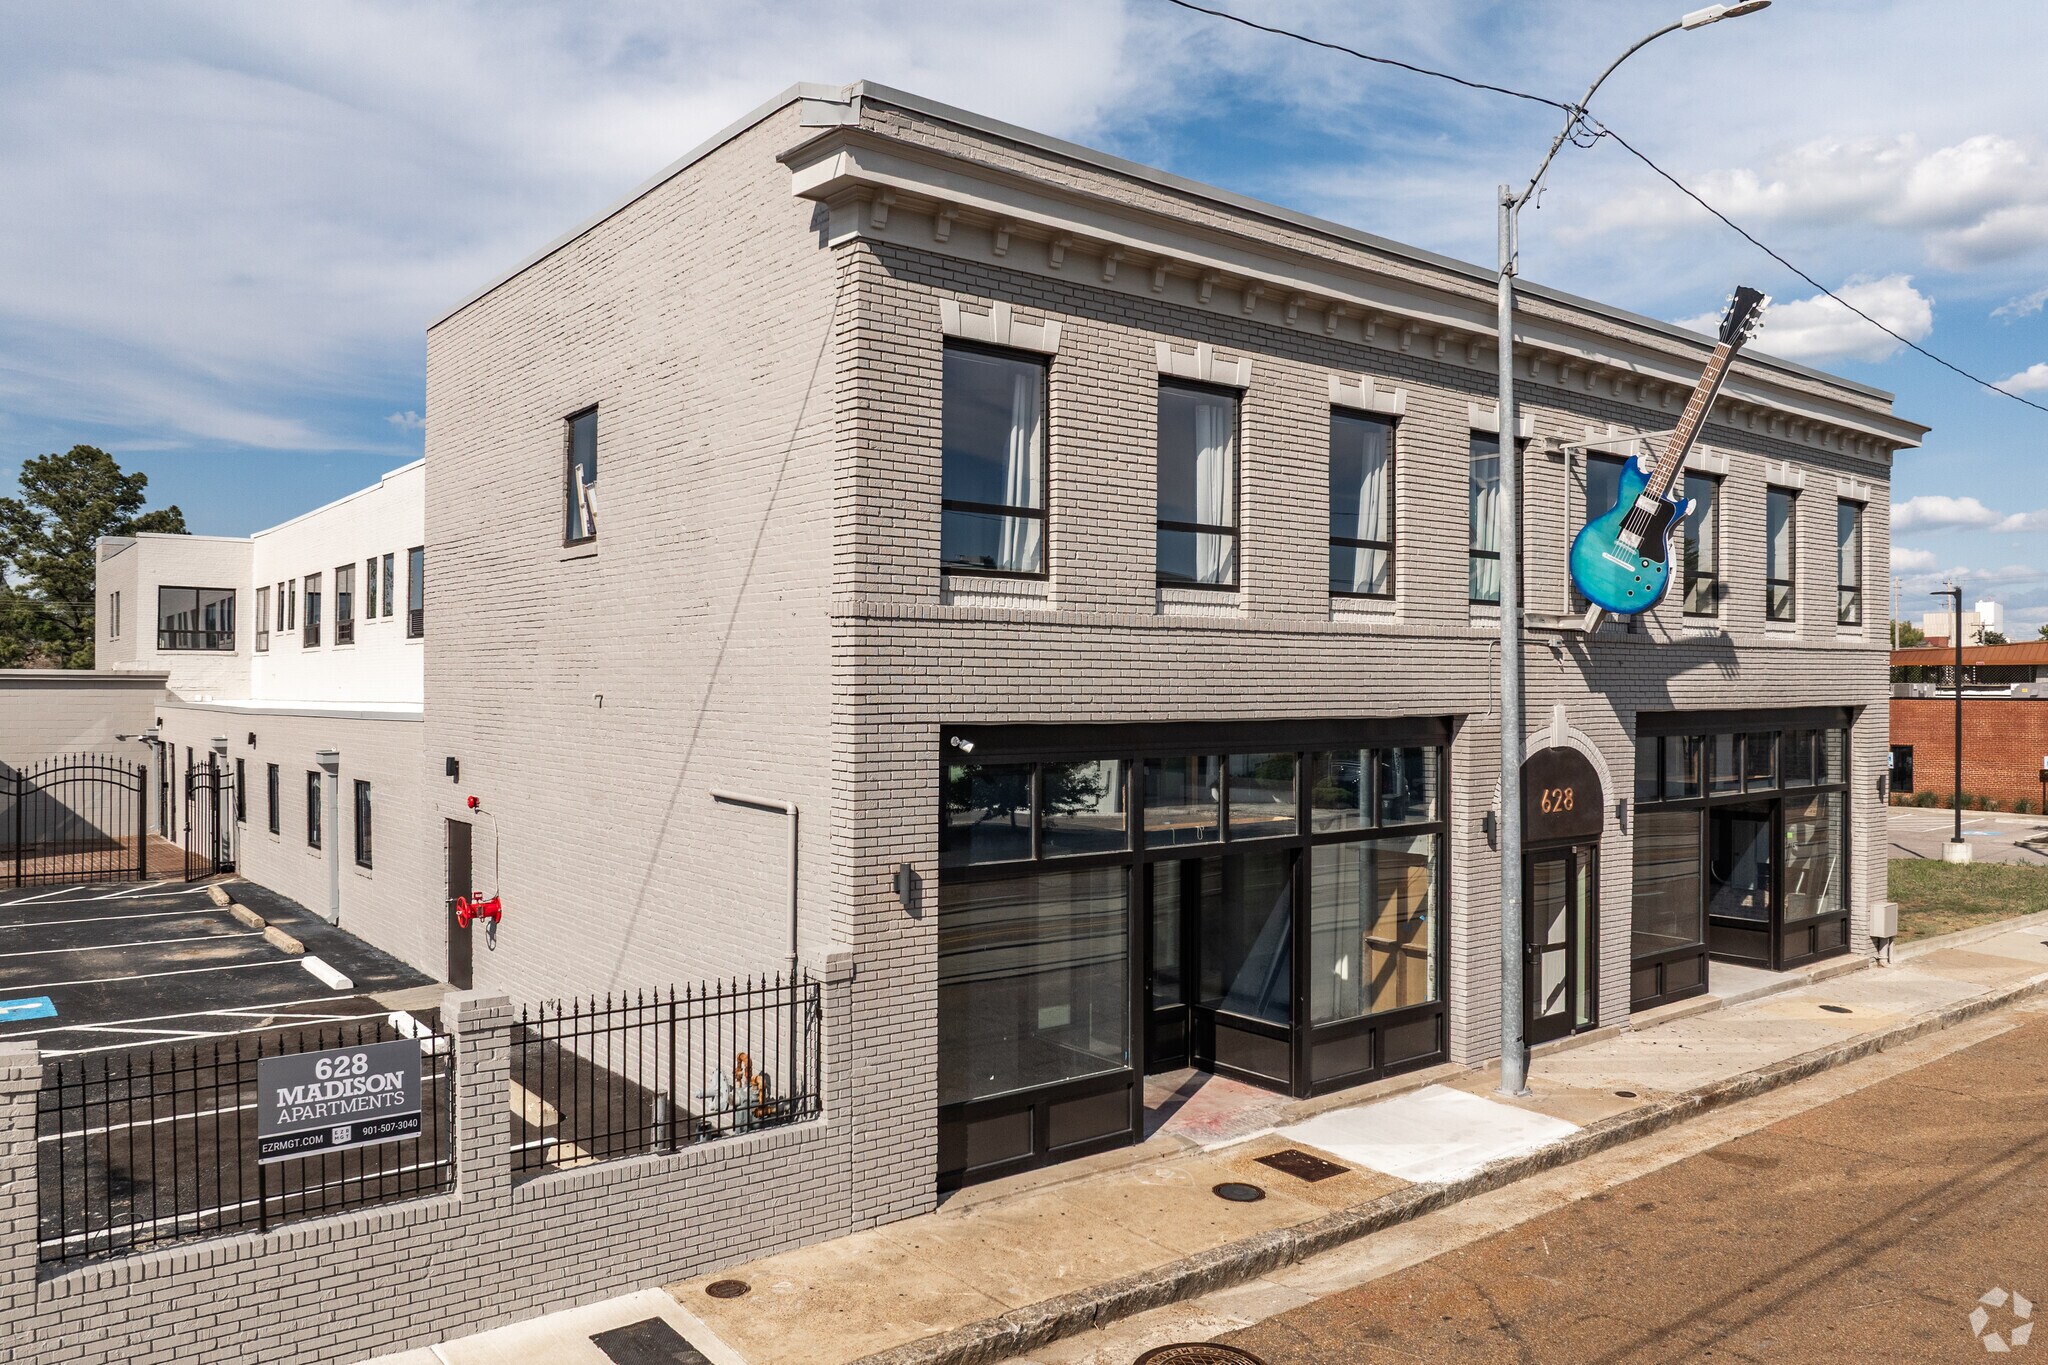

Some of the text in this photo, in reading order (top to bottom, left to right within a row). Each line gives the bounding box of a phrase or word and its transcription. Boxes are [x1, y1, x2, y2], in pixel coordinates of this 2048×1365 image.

[1541, 787, 1574, 814] 628
[315, 1053, 368, 1080] 628
[276, 1070, 405, 1108] MADISON
[276, 1090, 405, 1125] APARTMENTS
[334, 1128, 350, 1136] EZR
[362, 1118, 418, 1137] 901-507-3040
[262, 1134, 324, 1153] EZRMGT.COM
